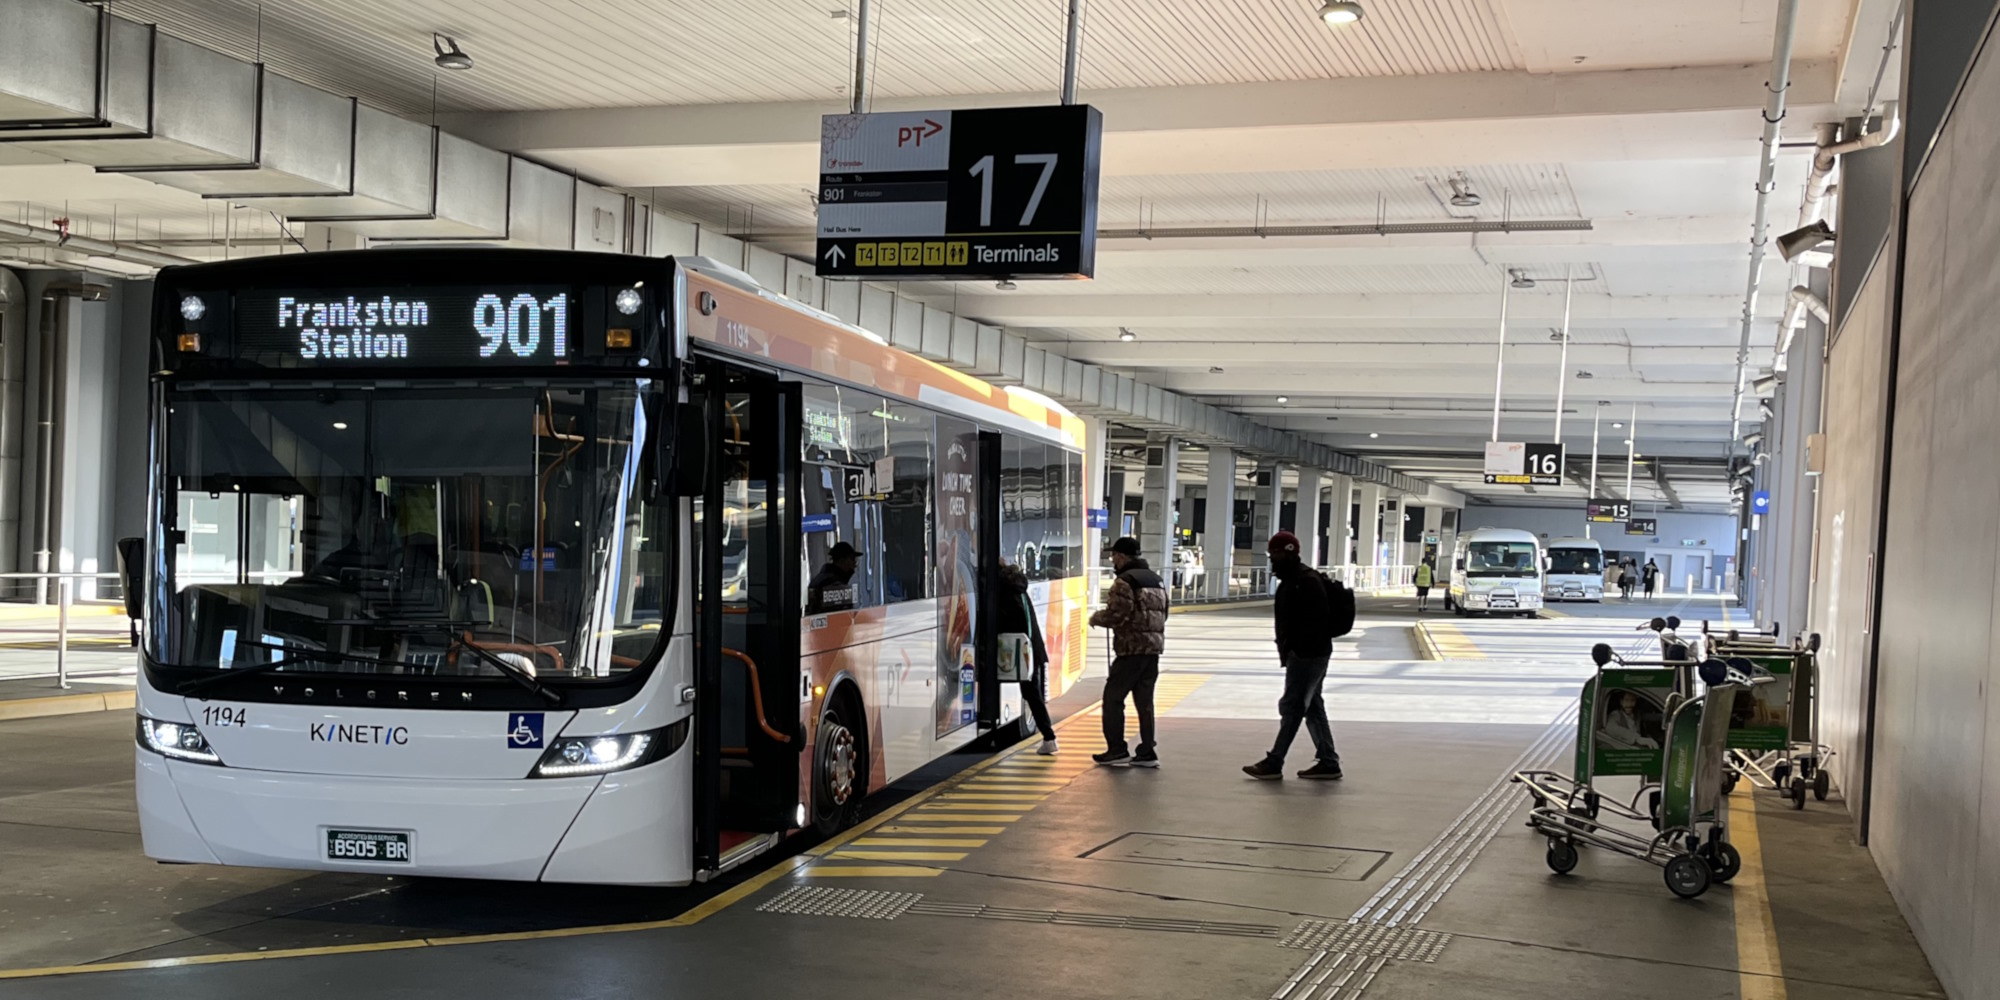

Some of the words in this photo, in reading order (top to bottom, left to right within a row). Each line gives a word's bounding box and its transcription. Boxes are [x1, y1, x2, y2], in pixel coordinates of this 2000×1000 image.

[824, 188, 845, 201] 901
[968, 152, 1058, 227] 17
[858, 248, 873, 261] T4
[880, 248, 896, 261] T3
[903, 247, 919, 261] T2
[926, 247, 941, 260] T1
[974, 243, 1059, 263] Terminals
[279, 296, 428, 327] Frankston
[473, 293, 567, 357] 901
[727, 321, 749, 349] 1194
[300, 328, 408, 358] Station
[810, 425, 833, 443] Station
[1529, 454, 1557, 474] 16
[1612, 504, 1629, 517] 15
[1642, 522, 1654, 531] 14
[274, 685, 473, 702] VOLGREN
[203, 706, 246, 728] 1194
[334, 839, 377, 858] BS05
[386, 841, 408, 859] BR
